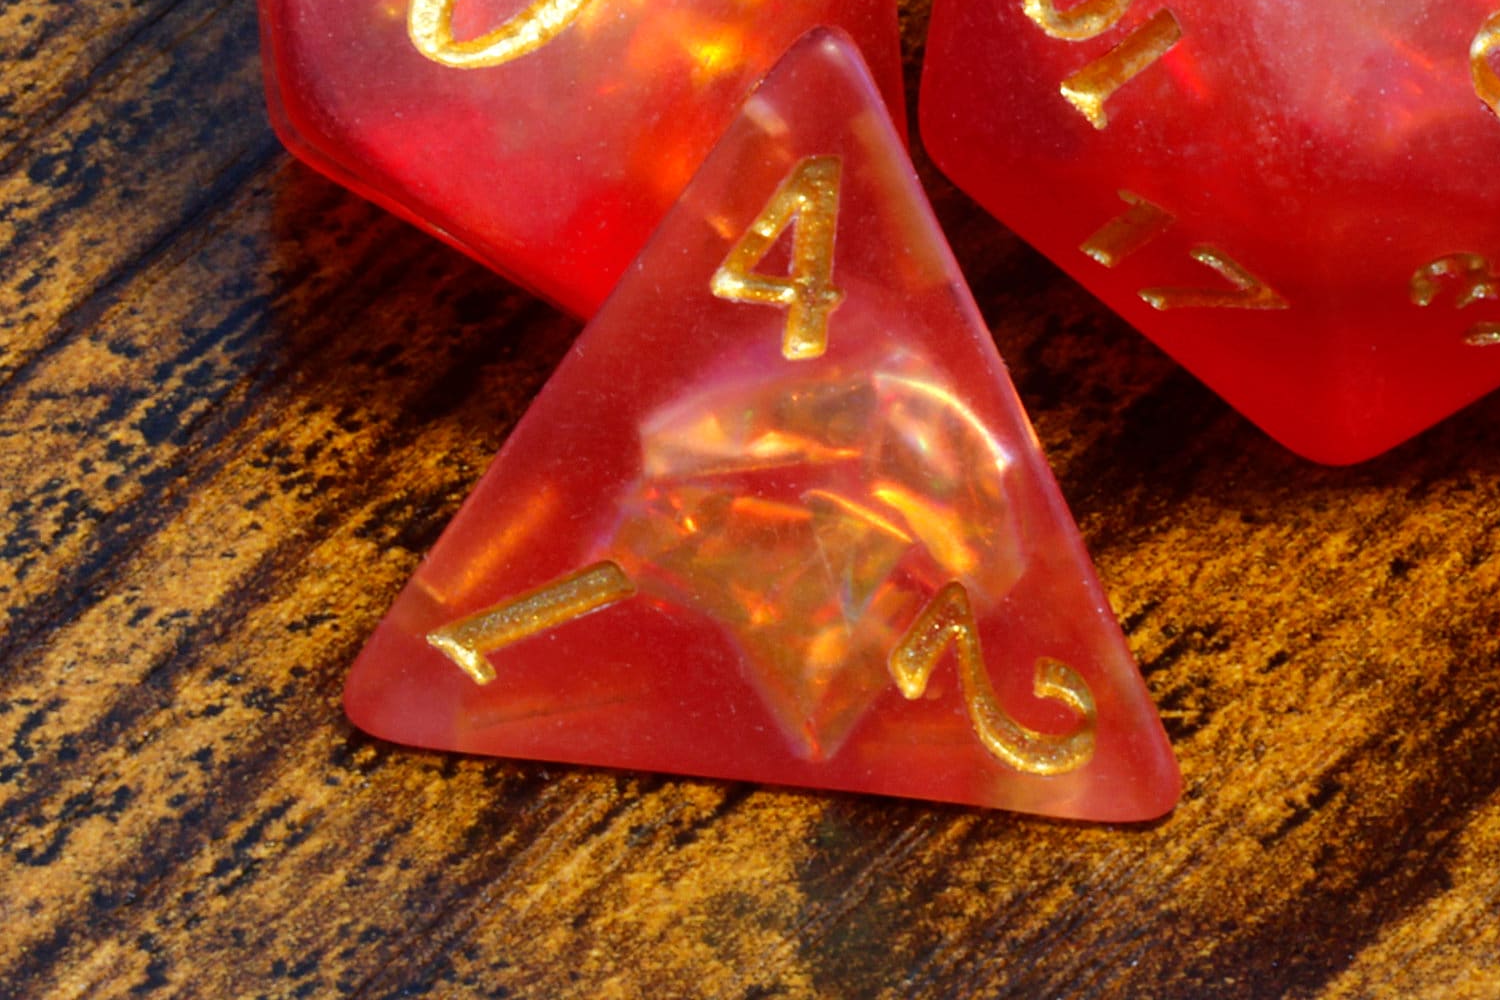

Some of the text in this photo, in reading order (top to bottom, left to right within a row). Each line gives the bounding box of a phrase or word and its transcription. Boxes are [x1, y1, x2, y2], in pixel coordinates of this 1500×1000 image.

[710, 153, 845, 360] 4
[426, 560, 637, 685] 1
[888, 581, 1098, 776] 2
